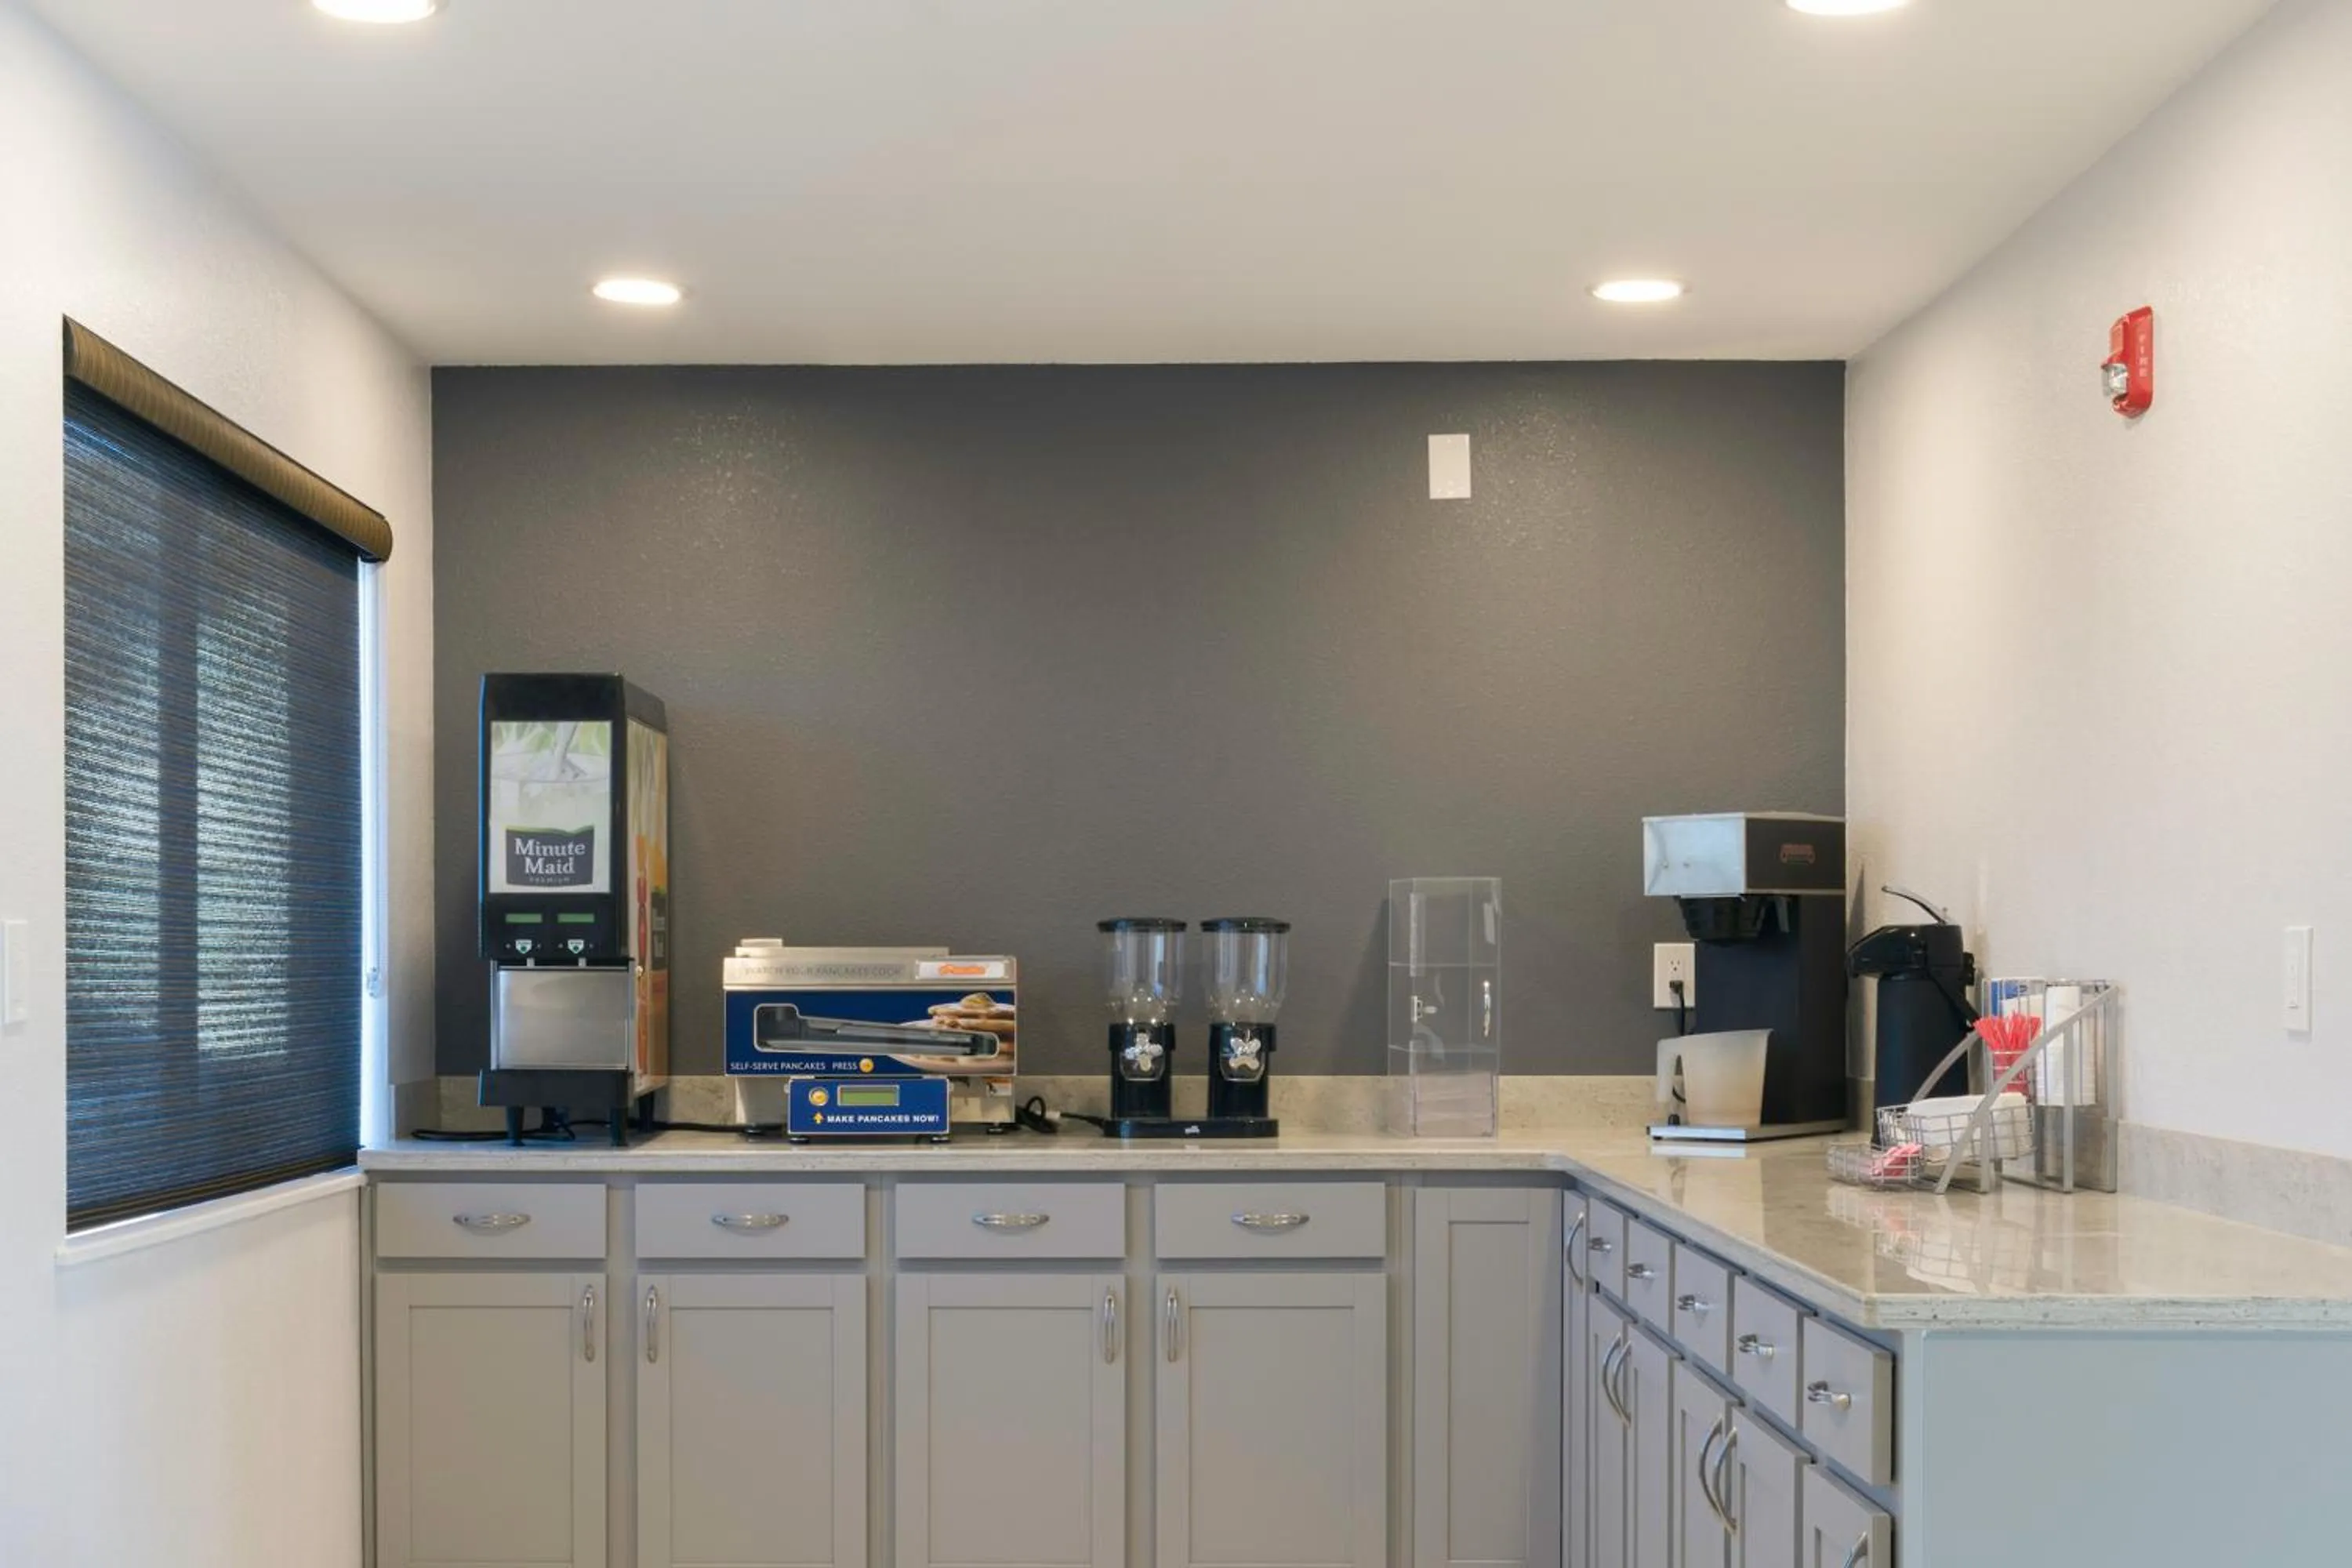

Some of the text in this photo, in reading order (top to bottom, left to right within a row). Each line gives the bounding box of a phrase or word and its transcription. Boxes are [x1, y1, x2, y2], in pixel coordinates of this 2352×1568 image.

[514, 837, 586, 856] Minute
[524, 856, 575, 874] Maid
[730, 1062, 858, 1071] SELF-SERVE PANCAKES PRESS
[826, 1115, 940, 1123] MAKE PANCAKES NOW!
